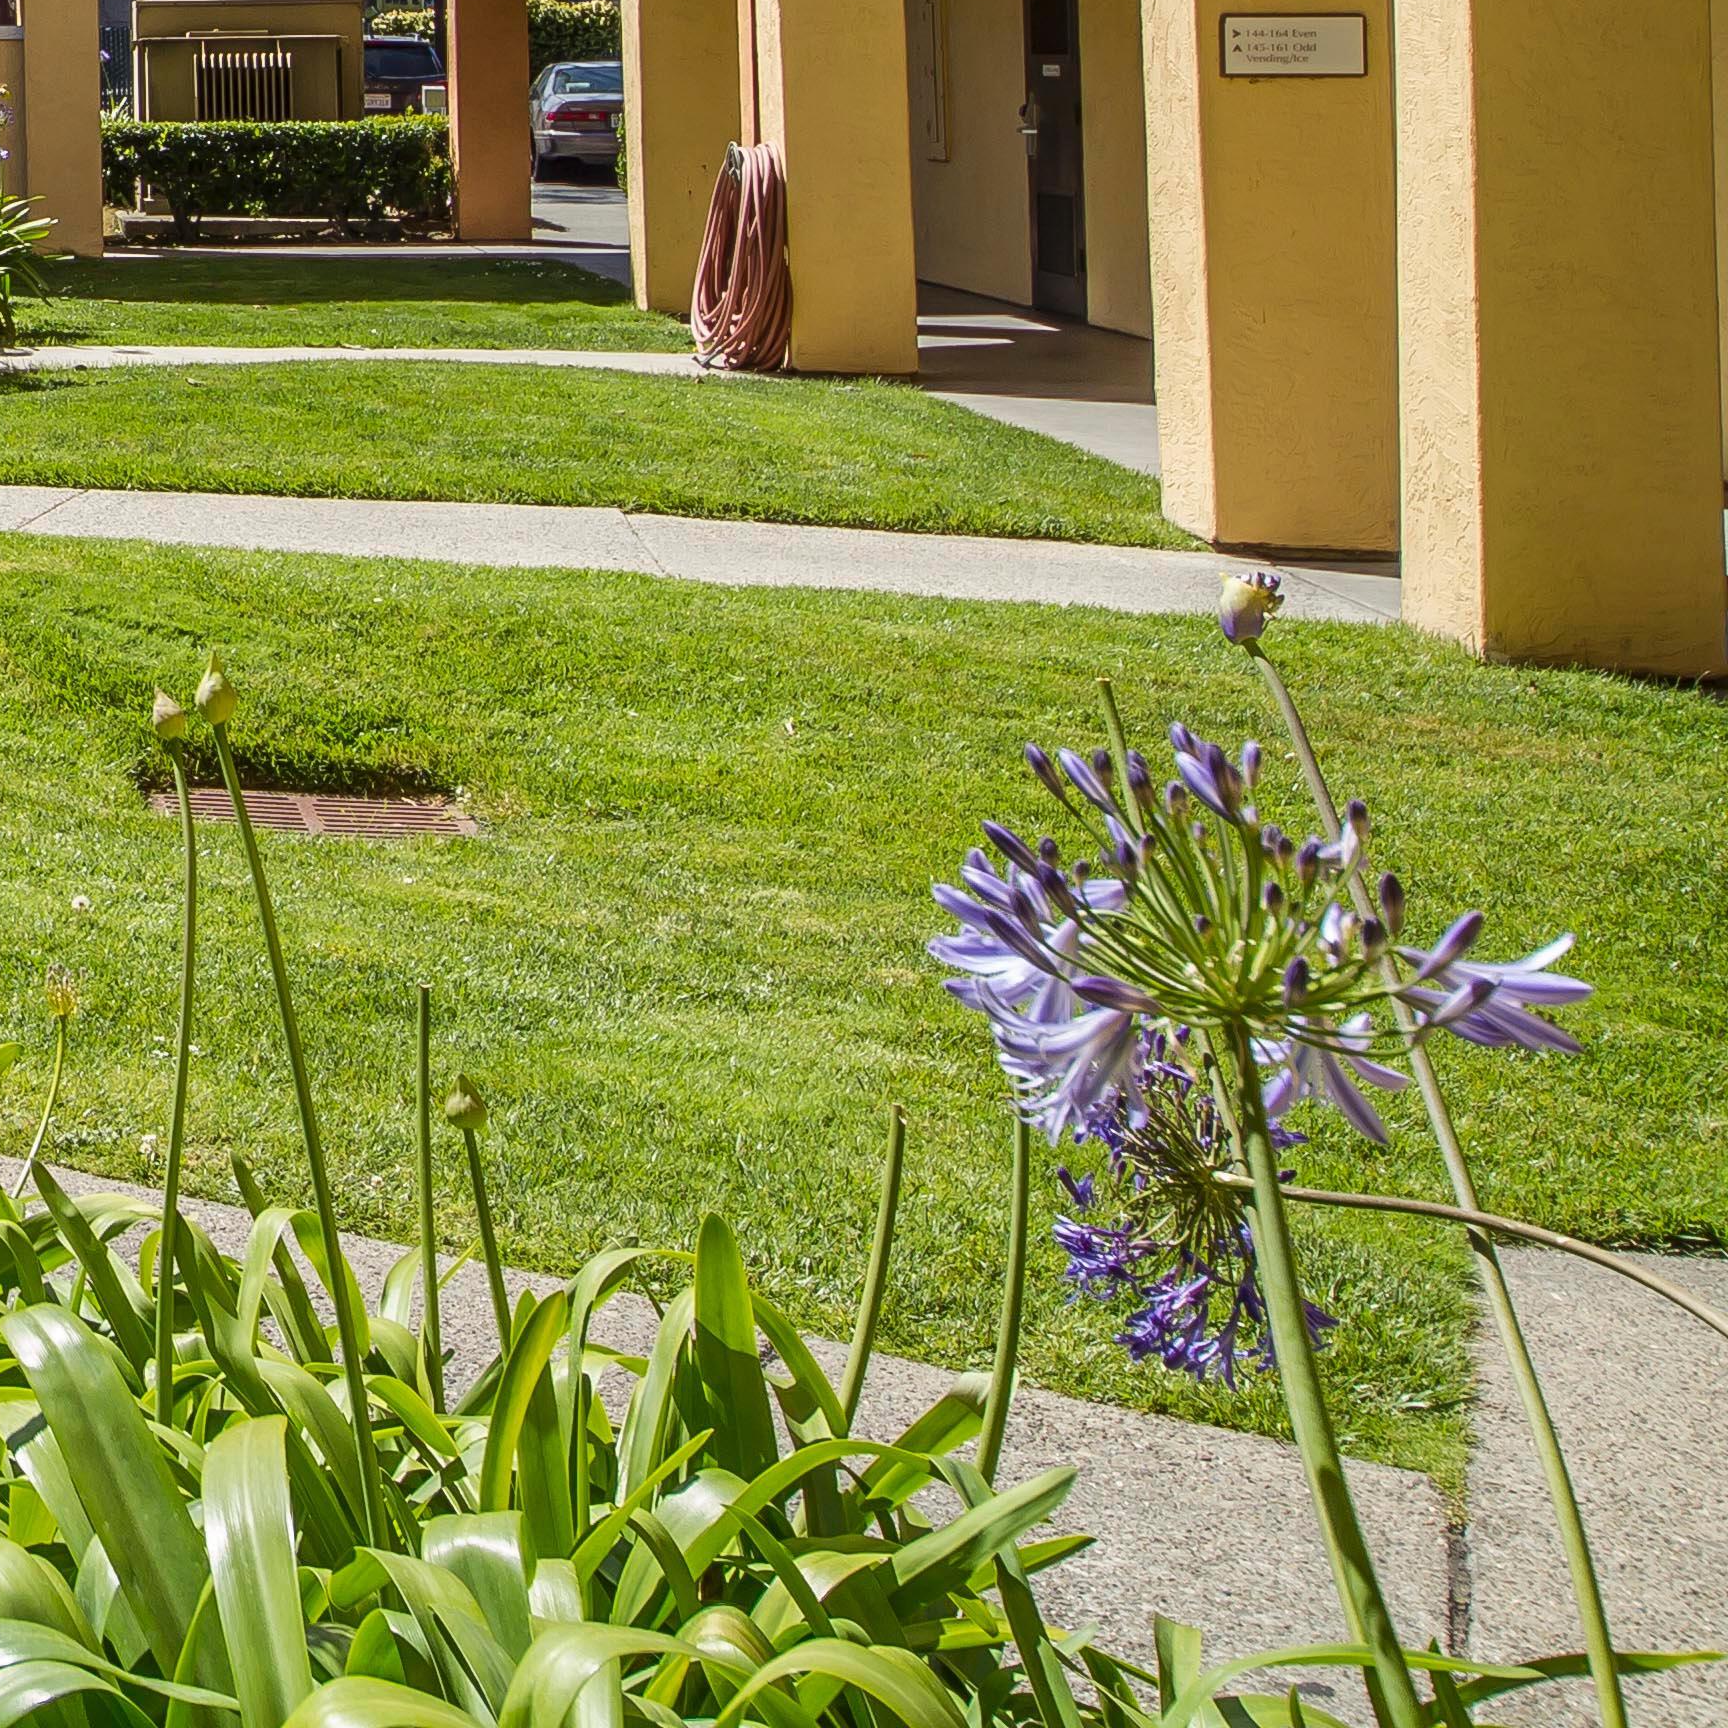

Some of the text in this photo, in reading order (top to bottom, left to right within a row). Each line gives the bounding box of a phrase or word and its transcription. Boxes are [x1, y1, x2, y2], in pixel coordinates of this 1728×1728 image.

[1246, 29, 1317, 38] 144-164 Even
[1293, 43, 1317, 52] Odd
[1246, 54, 1309, 64] Vending/Ice
